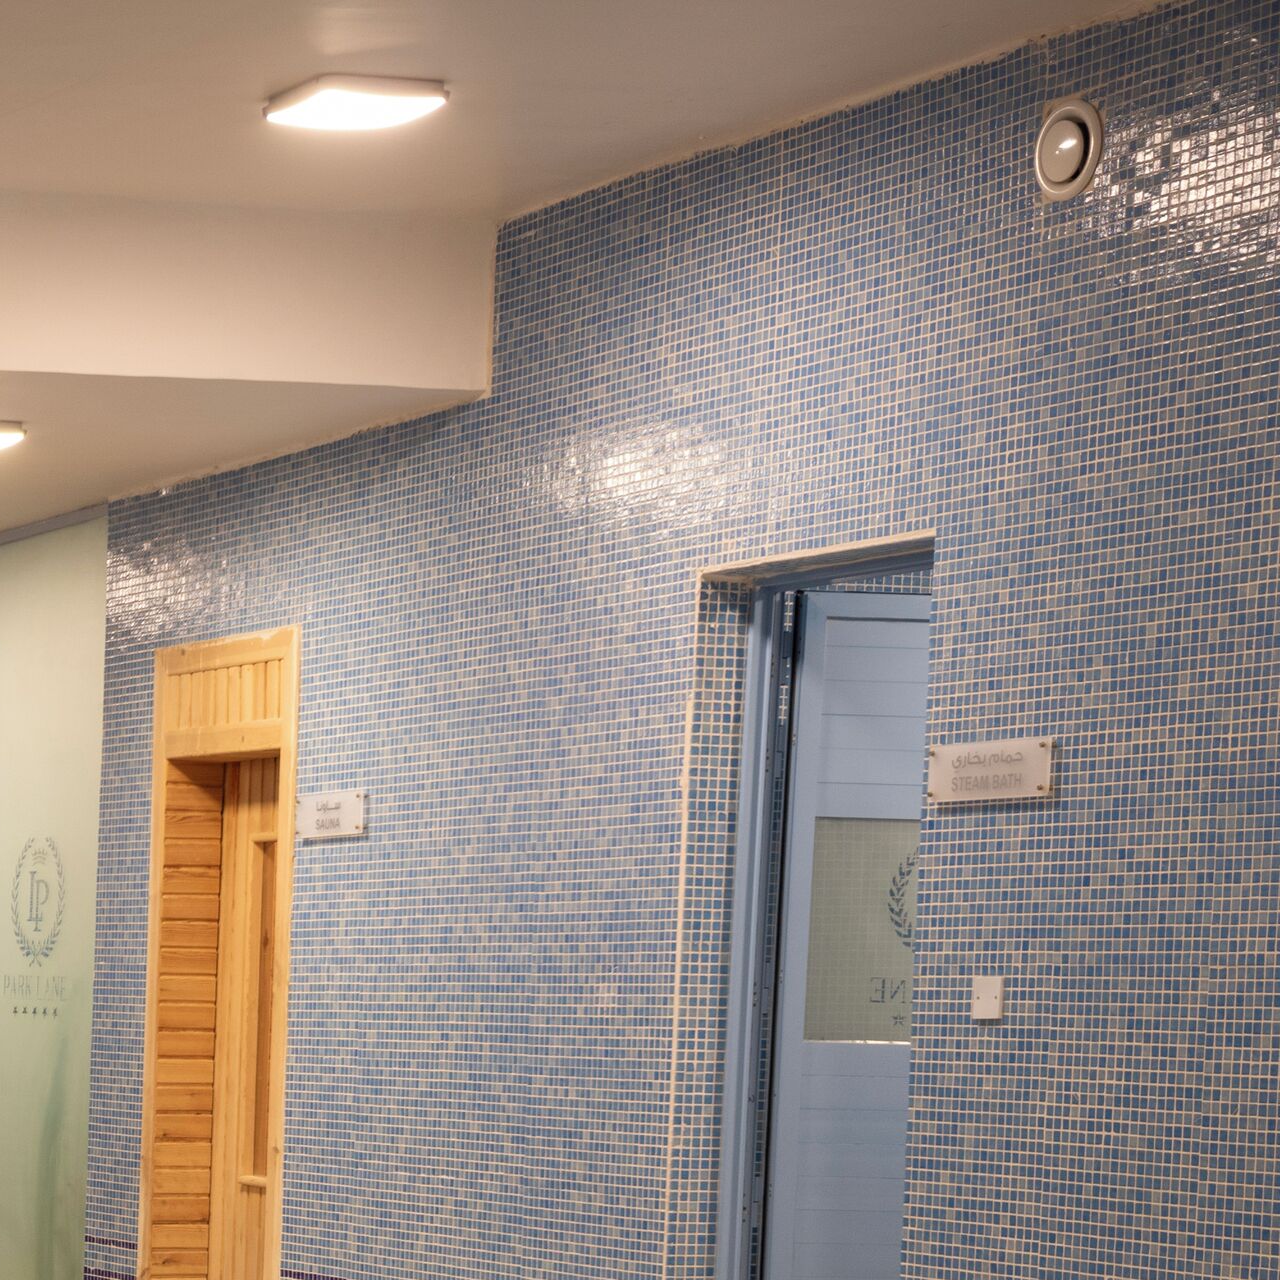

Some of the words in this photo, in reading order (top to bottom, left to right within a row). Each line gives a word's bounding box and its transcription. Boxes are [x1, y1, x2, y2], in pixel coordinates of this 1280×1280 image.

[951, 751, 987, 774] بخاري
[988, 750, 1024, 768] حمام
[951, 775, 989, 793] STEAM
[991, 772, 1022, 790] BATH
[315, 818, 340, 831] SAUNA
